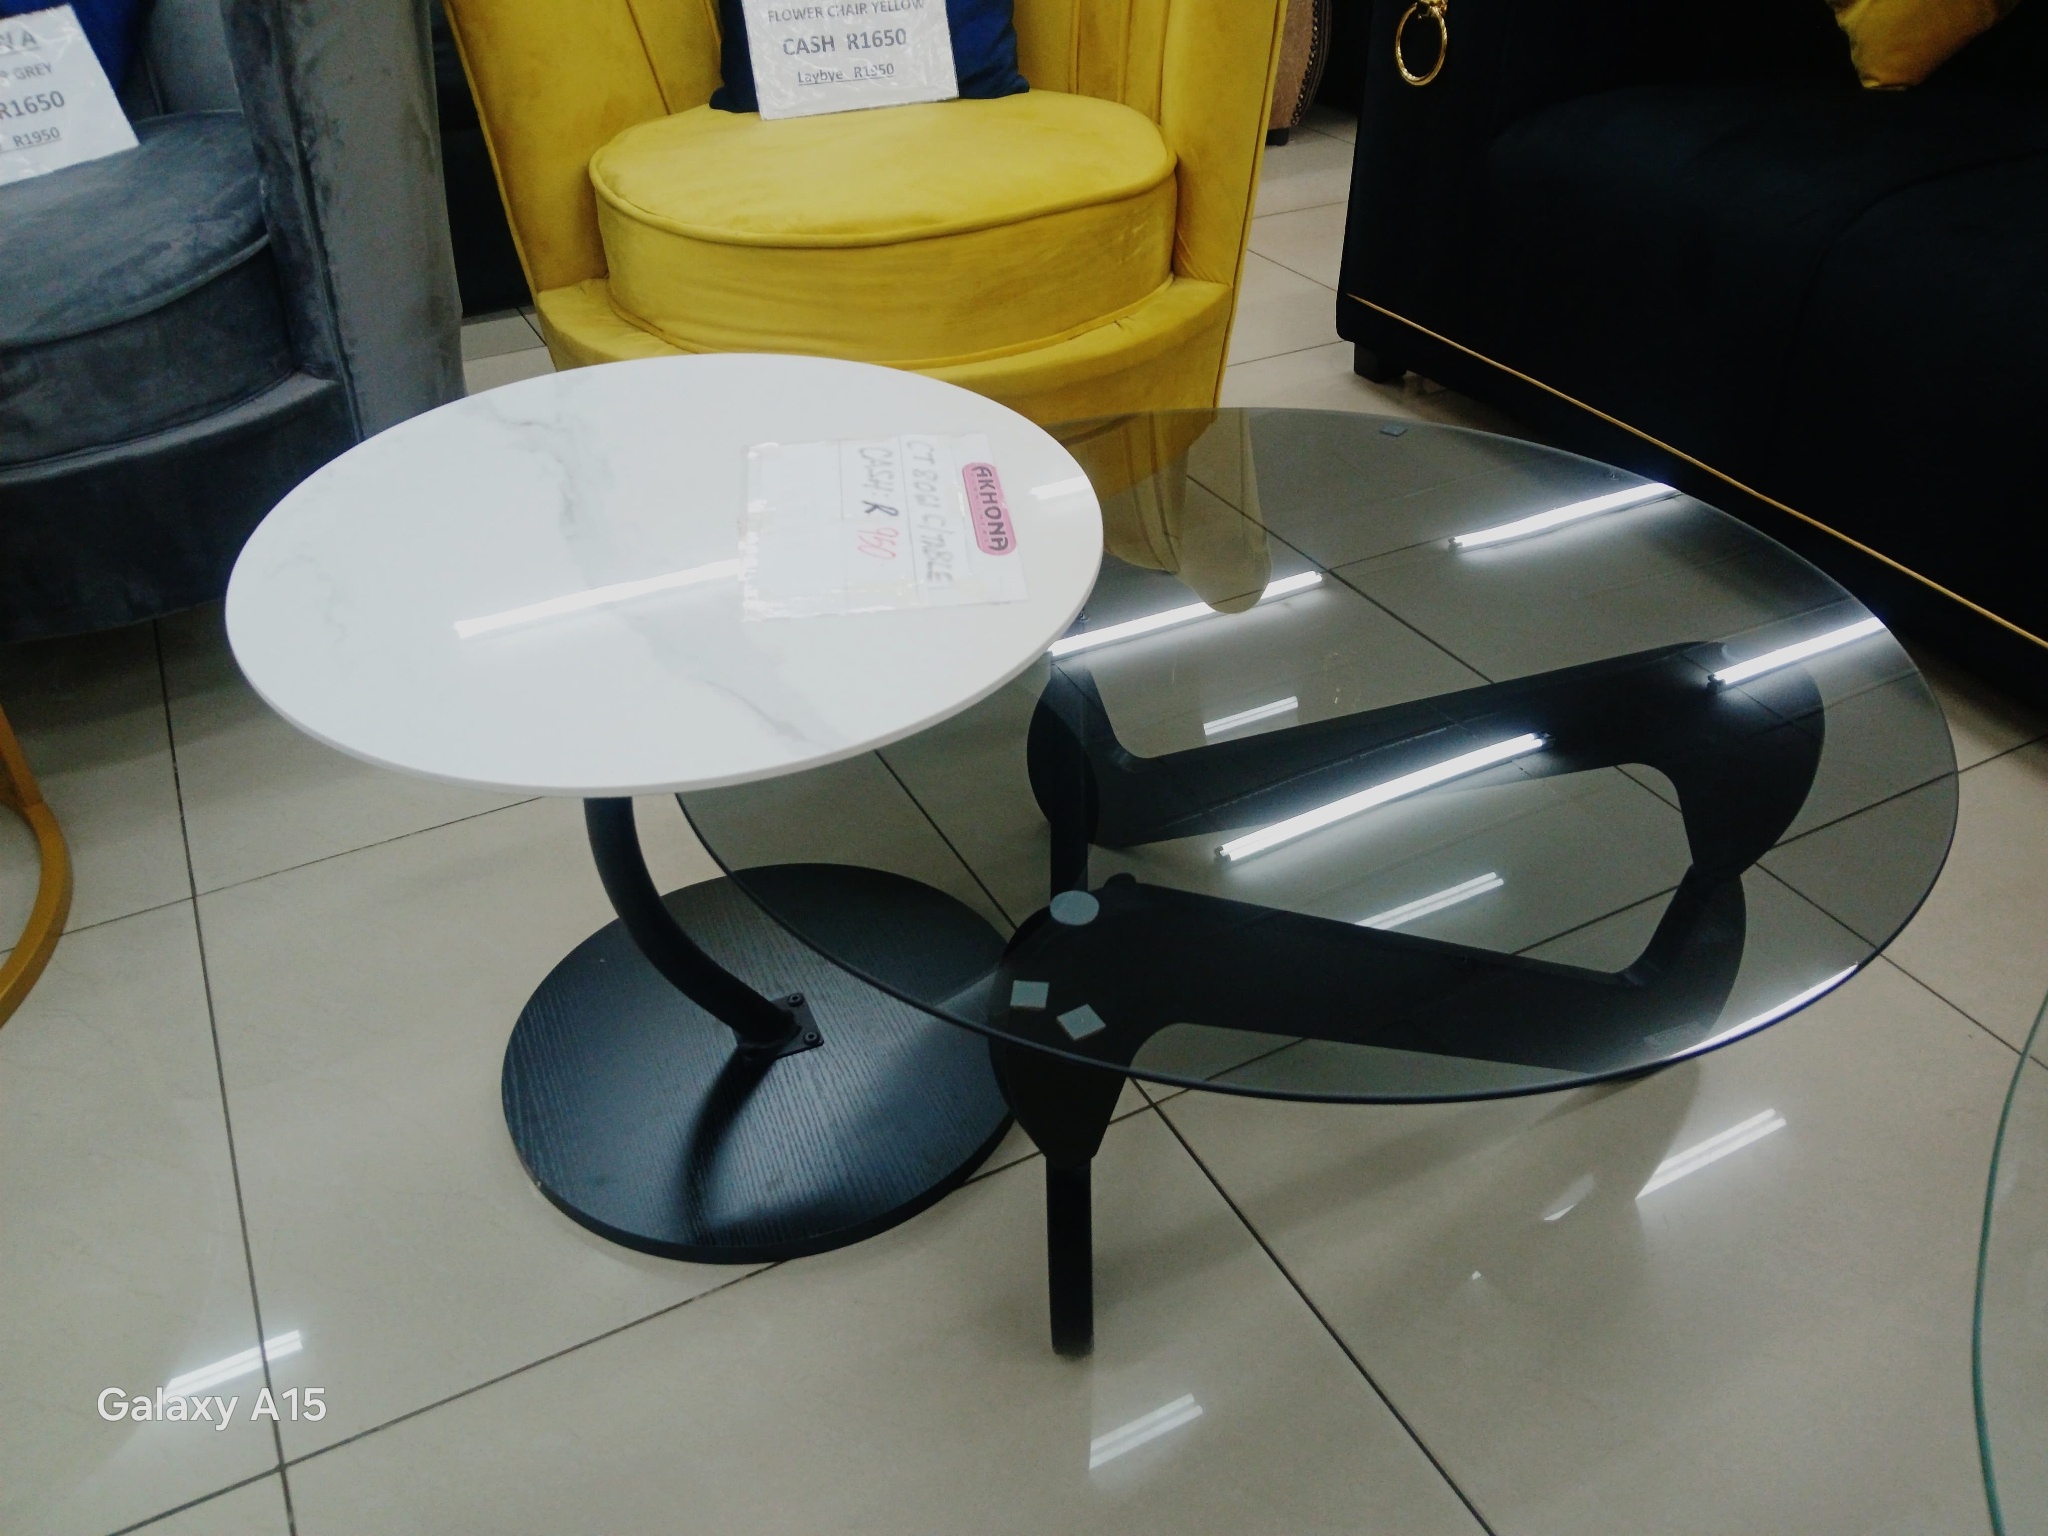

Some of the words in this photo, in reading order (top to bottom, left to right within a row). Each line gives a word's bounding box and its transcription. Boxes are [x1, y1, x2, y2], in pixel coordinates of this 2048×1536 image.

[768, 7, 824, 23] FLOWER
[827, 3, 868, 18] CHAIR
[871, 0, 924, 13] YELLOW
[783, 35, 836, 56] CASH
[847, 28, 907, 50] R1650
[12, 62, 52, 80] GREY
[798, 69, 843, 84] Laybye
[0, 90, 65, 120] R1650
[12, 126, 60, 147] R1950
[971, 465, 1009, 552] AKHONA
